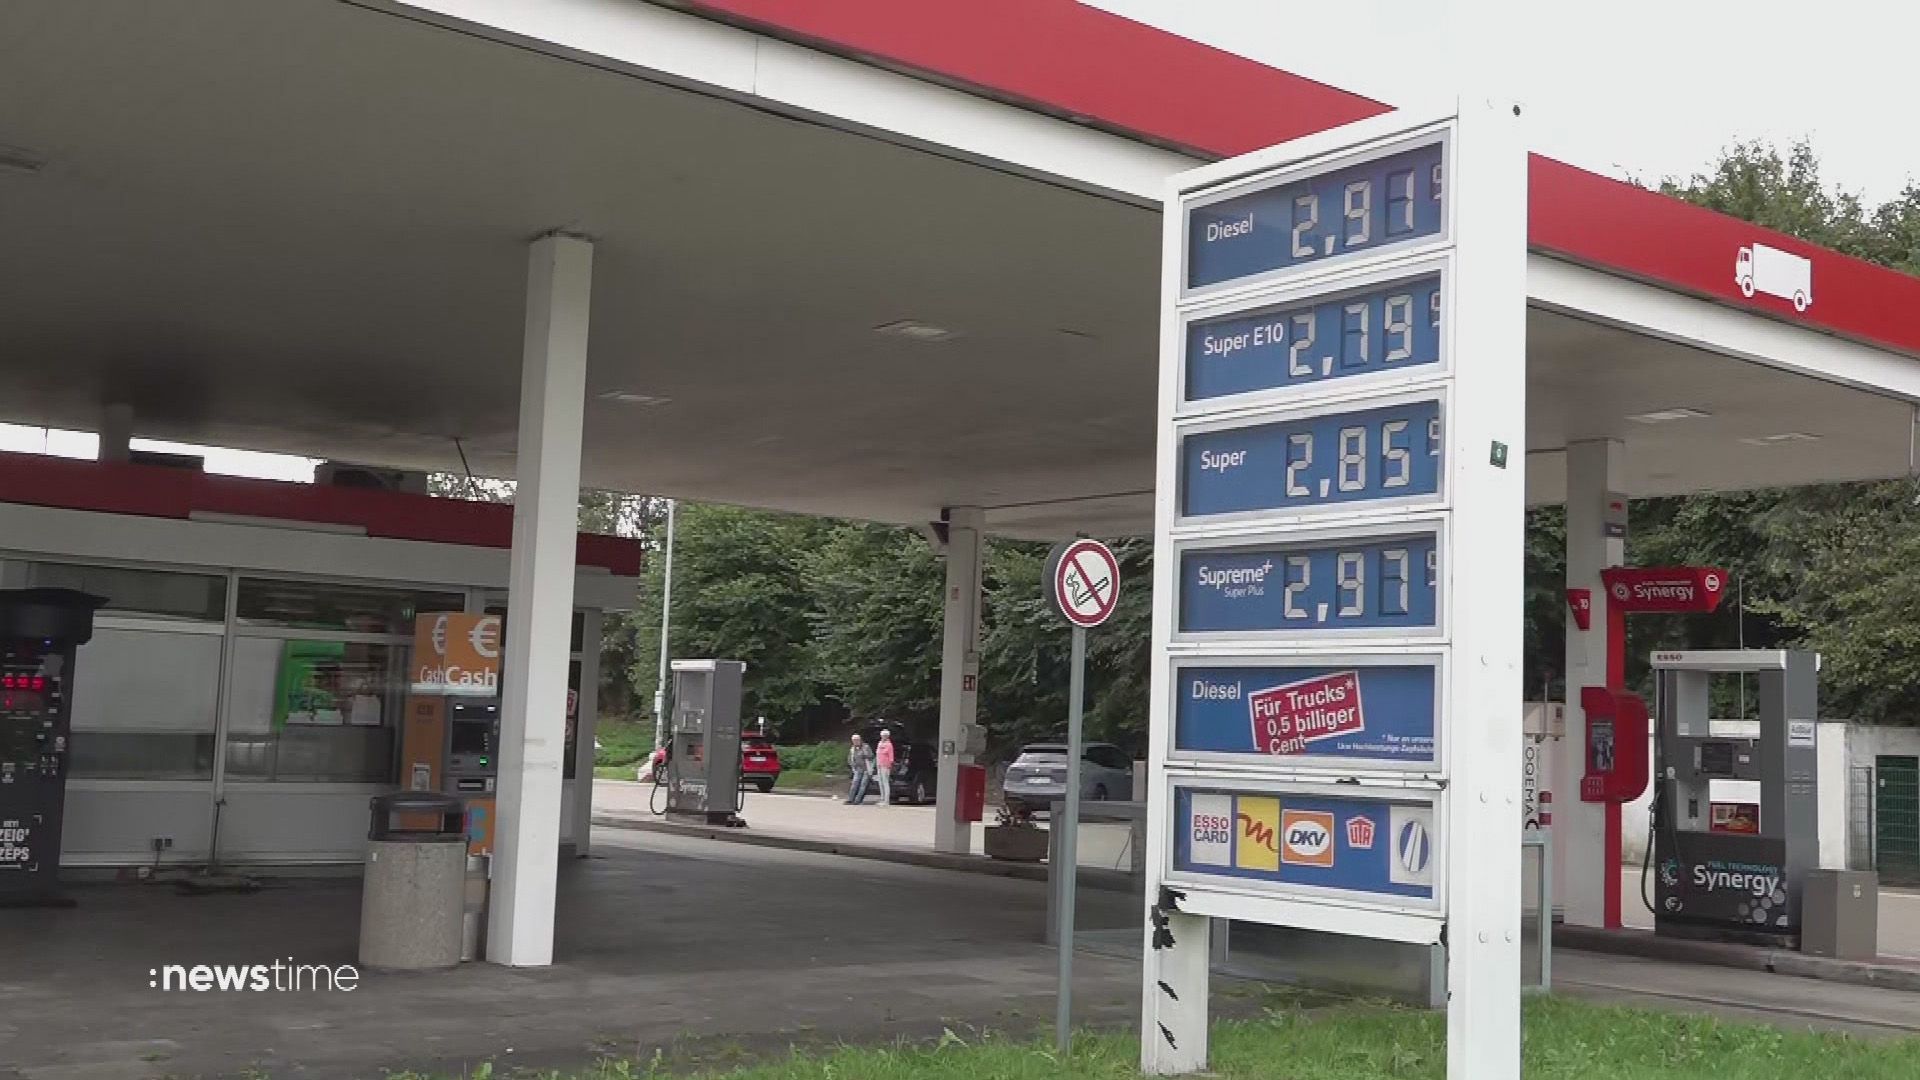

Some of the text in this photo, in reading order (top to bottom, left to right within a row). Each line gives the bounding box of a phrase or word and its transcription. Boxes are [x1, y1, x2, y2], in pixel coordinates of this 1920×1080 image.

[1206, 212, 1254, 242] Diesel
[1203, 332, 1250, 358] Super
[1252, 322, 1284, 347] E10
[1200, 449, 1247, 473] Super
[1223, 585, 1265, 599] Super Plus
[1632, 583, 1695, 601] Synergy
[420, 664, 445, 686] Cash
[445, 665, 498, 688] Cash
[1191, 680, 1242, 700] Diesel
[1254, 696, 1282, 718] Für
[1266, 707, 1356, 736] 0,5 billiger
[1269, 735, 1306, 755] Cent
[1193, 814, 1229, 830] ESSO
[1349, 817, 1373, 846] UTA
[1193, 829, 1229, 844] CARD
[1288, 829, 1327, 848] DKV
[1693, 864, 1779, 897] Synergy
